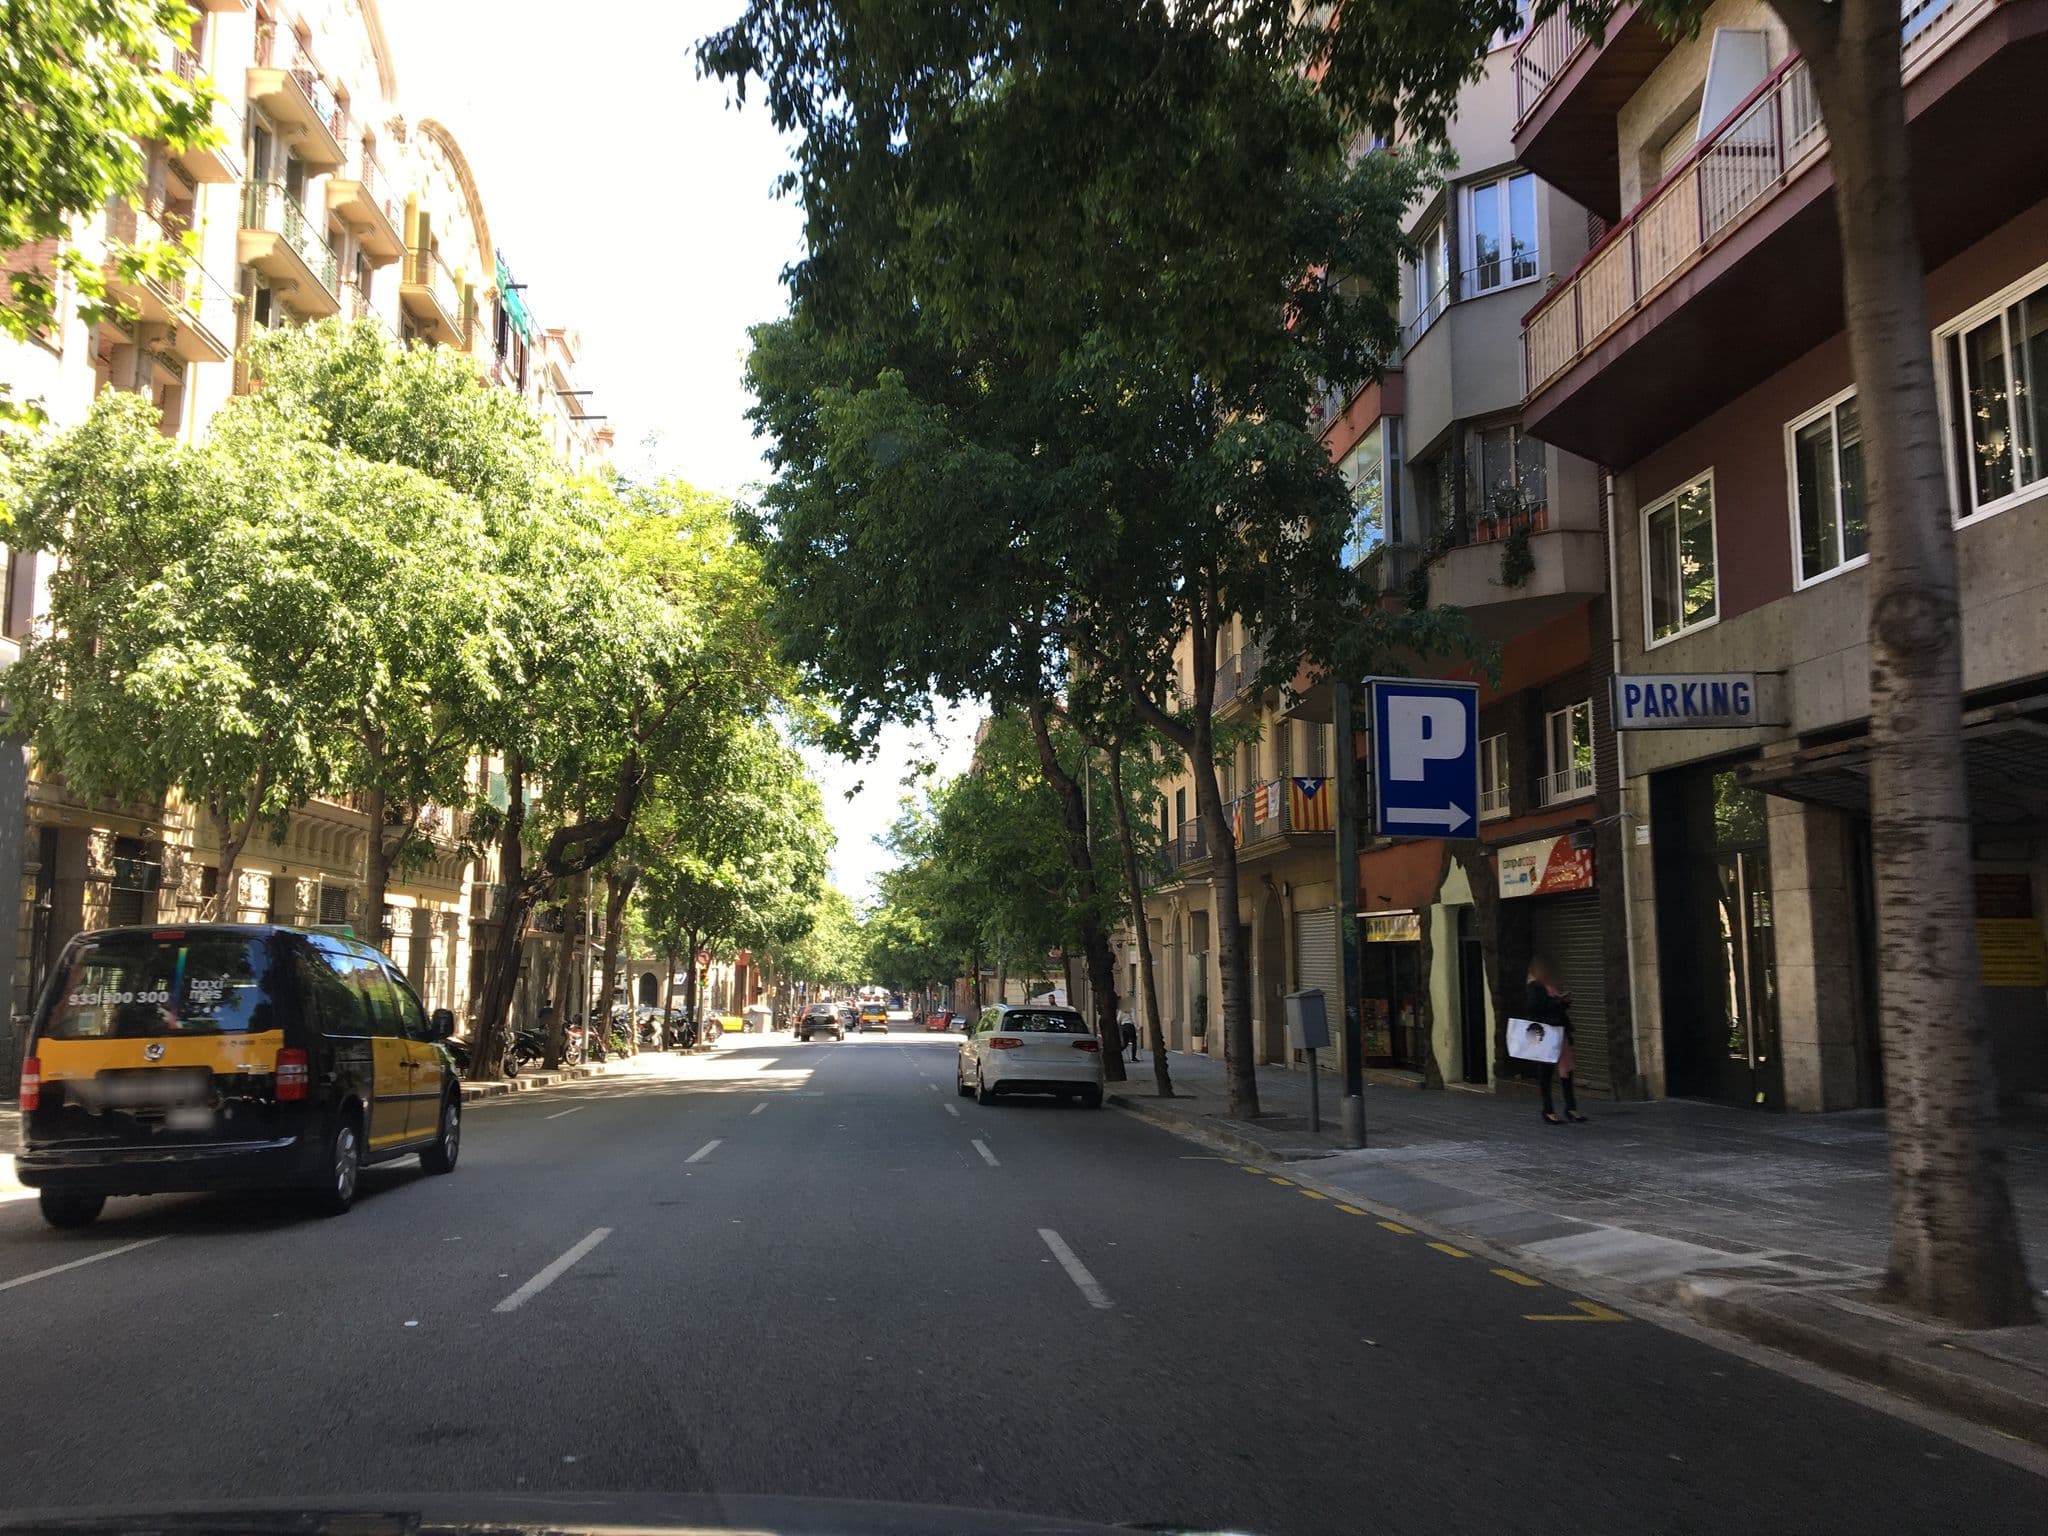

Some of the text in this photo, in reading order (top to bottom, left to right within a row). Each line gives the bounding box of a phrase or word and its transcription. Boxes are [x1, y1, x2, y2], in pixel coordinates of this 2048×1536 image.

[1624, 681, 1751, 719] PARKING
[1388, 695, 1467, 782] P
[67, 994, 99, 1006] 933
[136, 991, 170, 1004] 300
